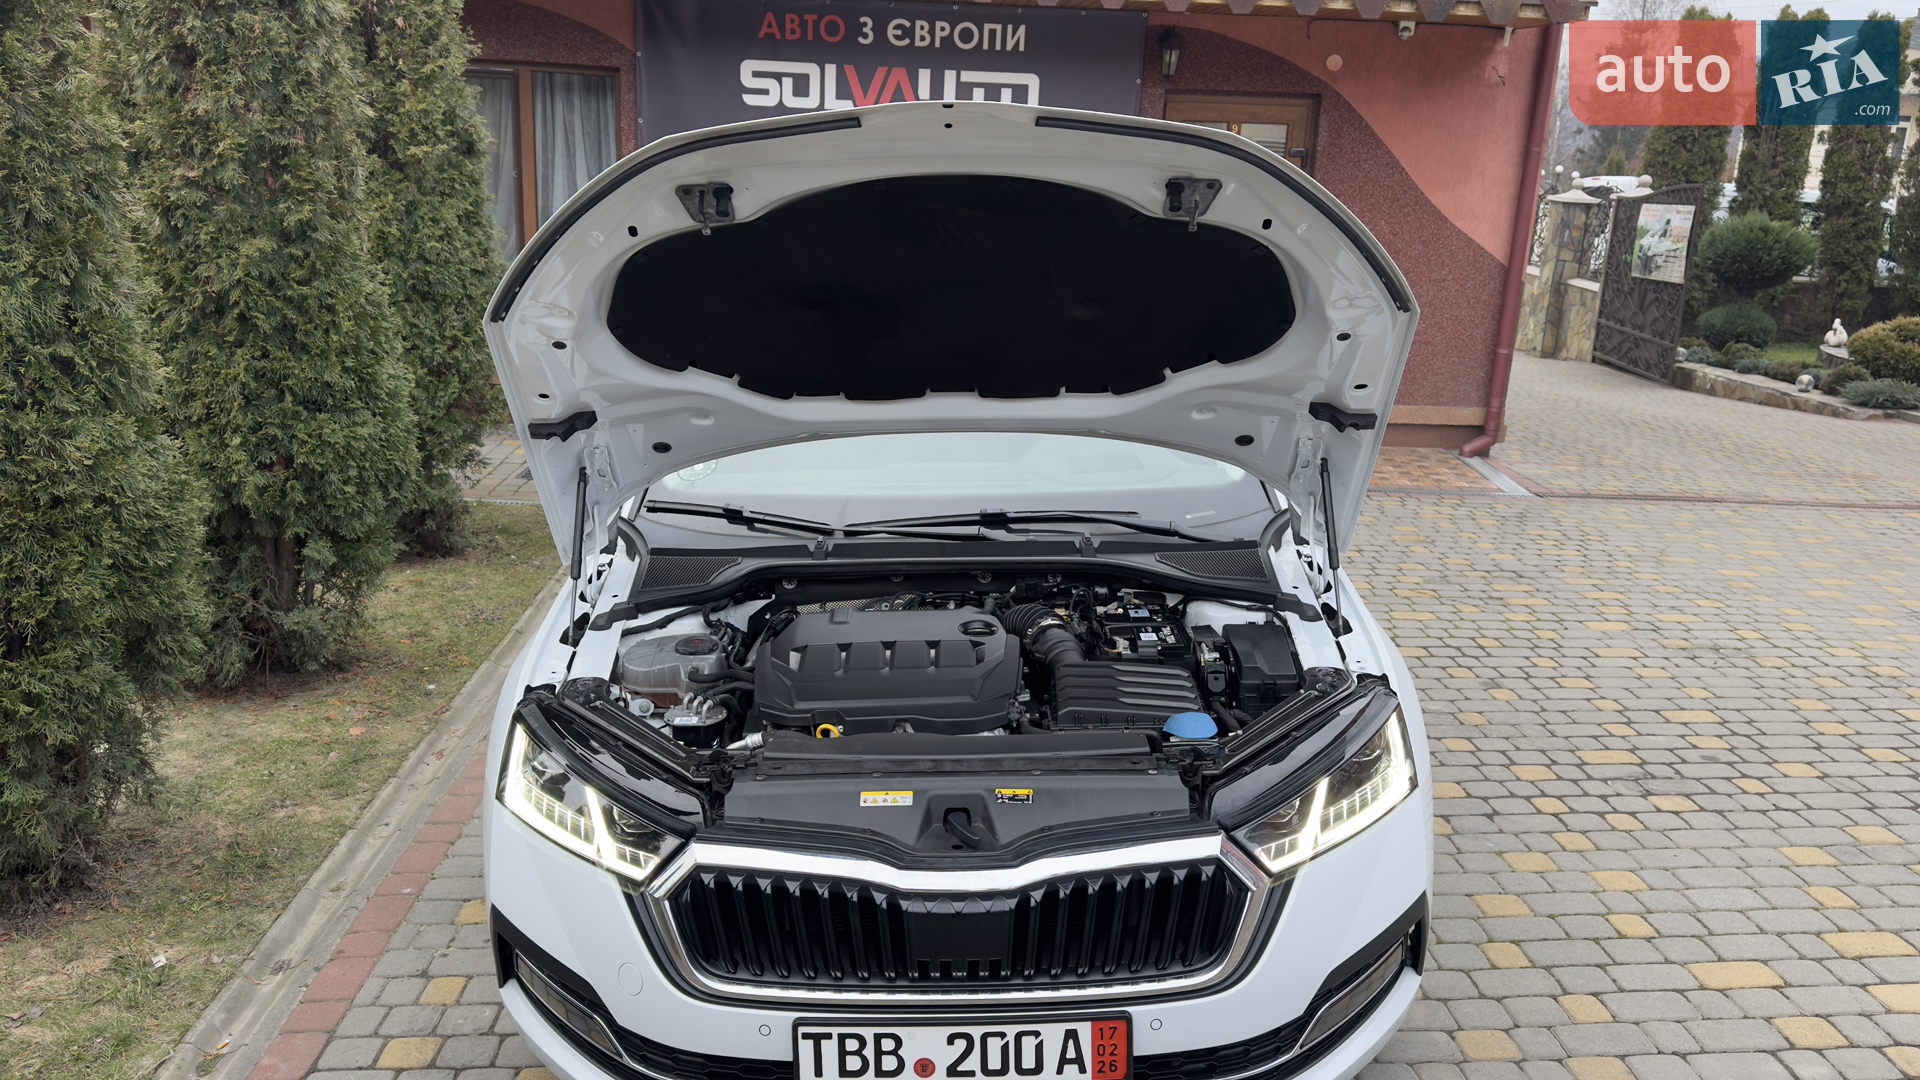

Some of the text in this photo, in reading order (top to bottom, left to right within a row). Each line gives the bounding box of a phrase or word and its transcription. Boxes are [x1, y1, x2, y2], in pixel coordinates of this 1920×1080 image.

[758, 11, 845, 43] АВТО
[887, 18, 1026, 51] ЄВРОПИ
[1232, 124, 1238, 133] 9
[1098, 1026, 1118, 1040] 17
[801, 1028, 1087, 1079] TBB 200 A
[1097, 1043, 1118, 1057] 02
[1097, 1059, 1118, 1074] 26
